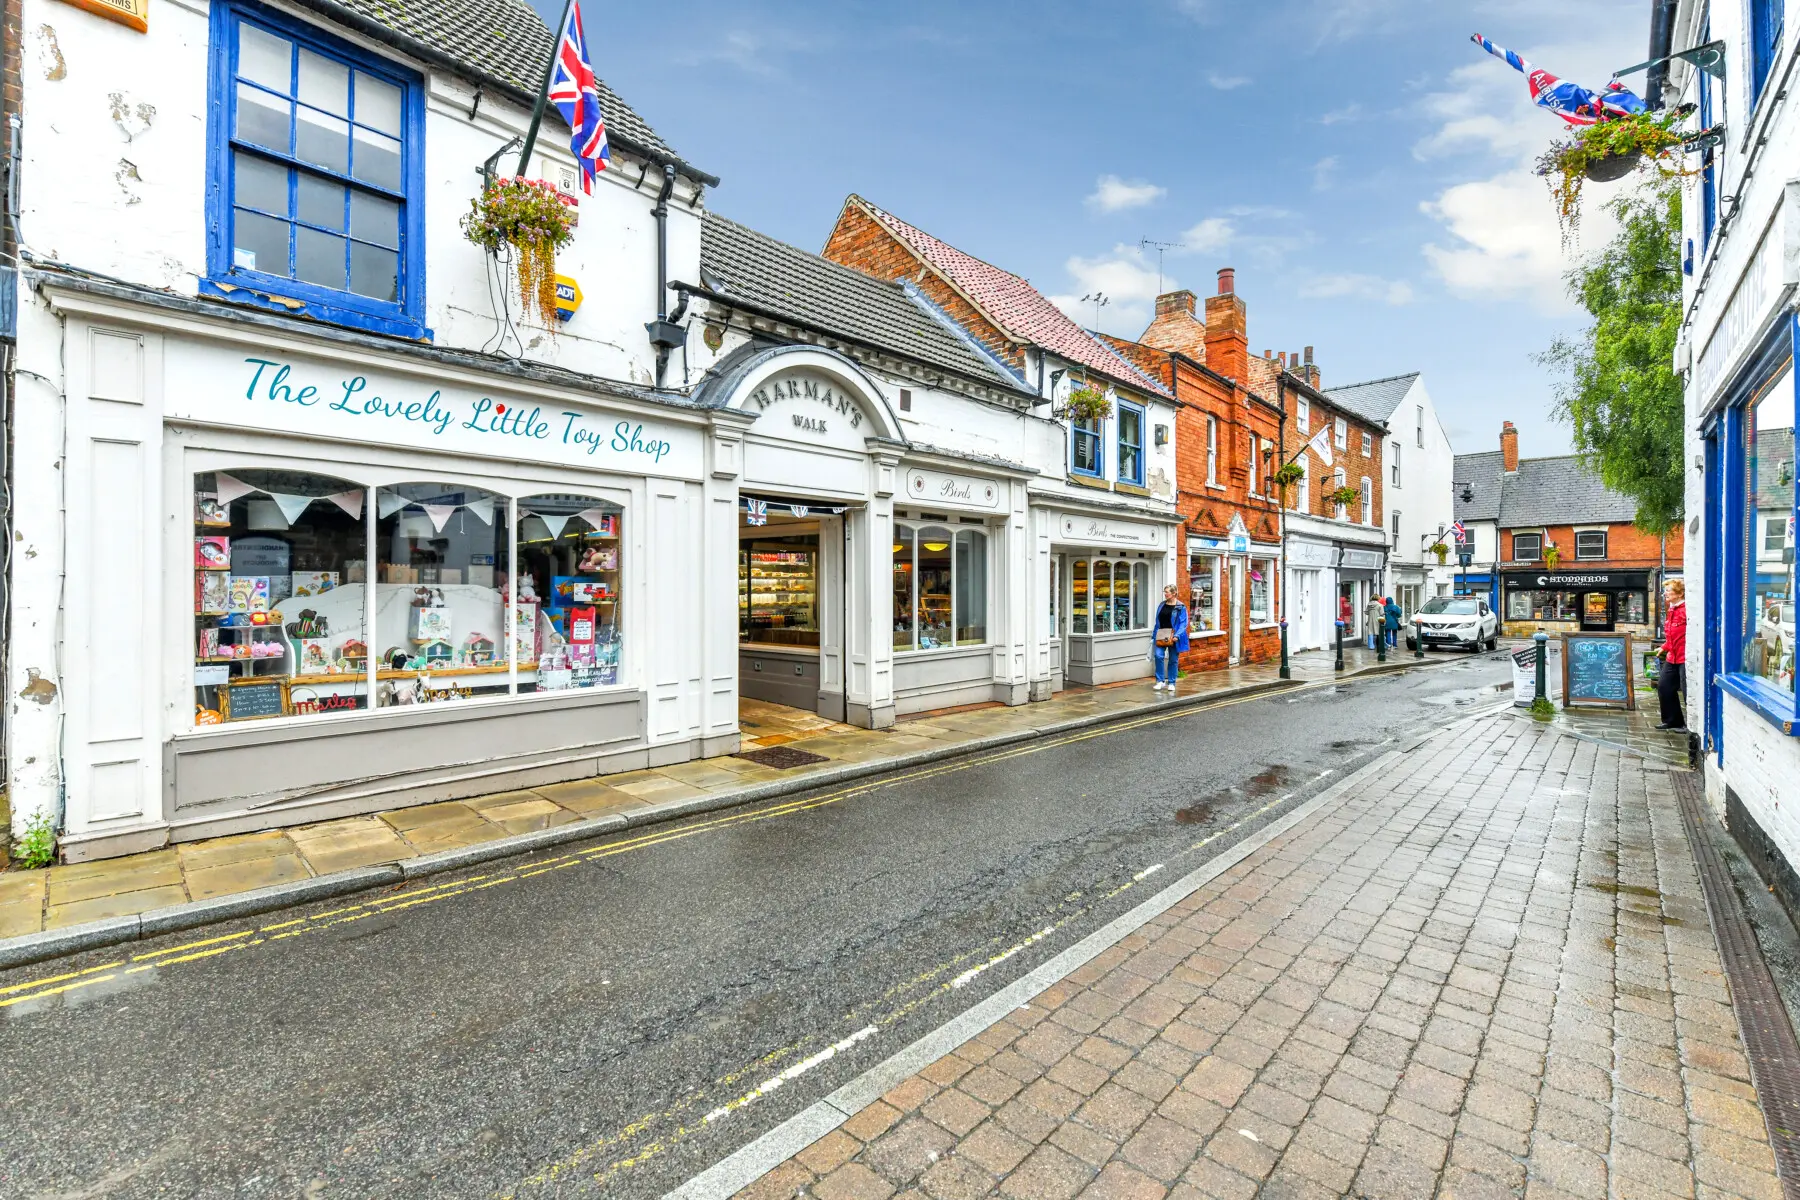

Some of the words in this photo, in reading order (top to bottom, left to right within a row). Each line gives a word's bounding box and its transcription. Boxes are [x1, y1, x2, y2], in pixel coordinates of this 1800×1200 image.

[1532, 72, 1565, 112] August
[556, 283, 575, 300] ADT
[245, 358, 320, 406] The
[329, 376, 455, 435] Lovely
[462, 397, 549, 439] Little
[562, 411, 604, 455] Toy
[611, 421, 671, 464] Shop
[753, 379, 862, 429] HARMAN'S
[792, 414, 828, 433] WALK
[940, 478, 971, 500] Birds
[1087, 520, 1108, 539] Birds
